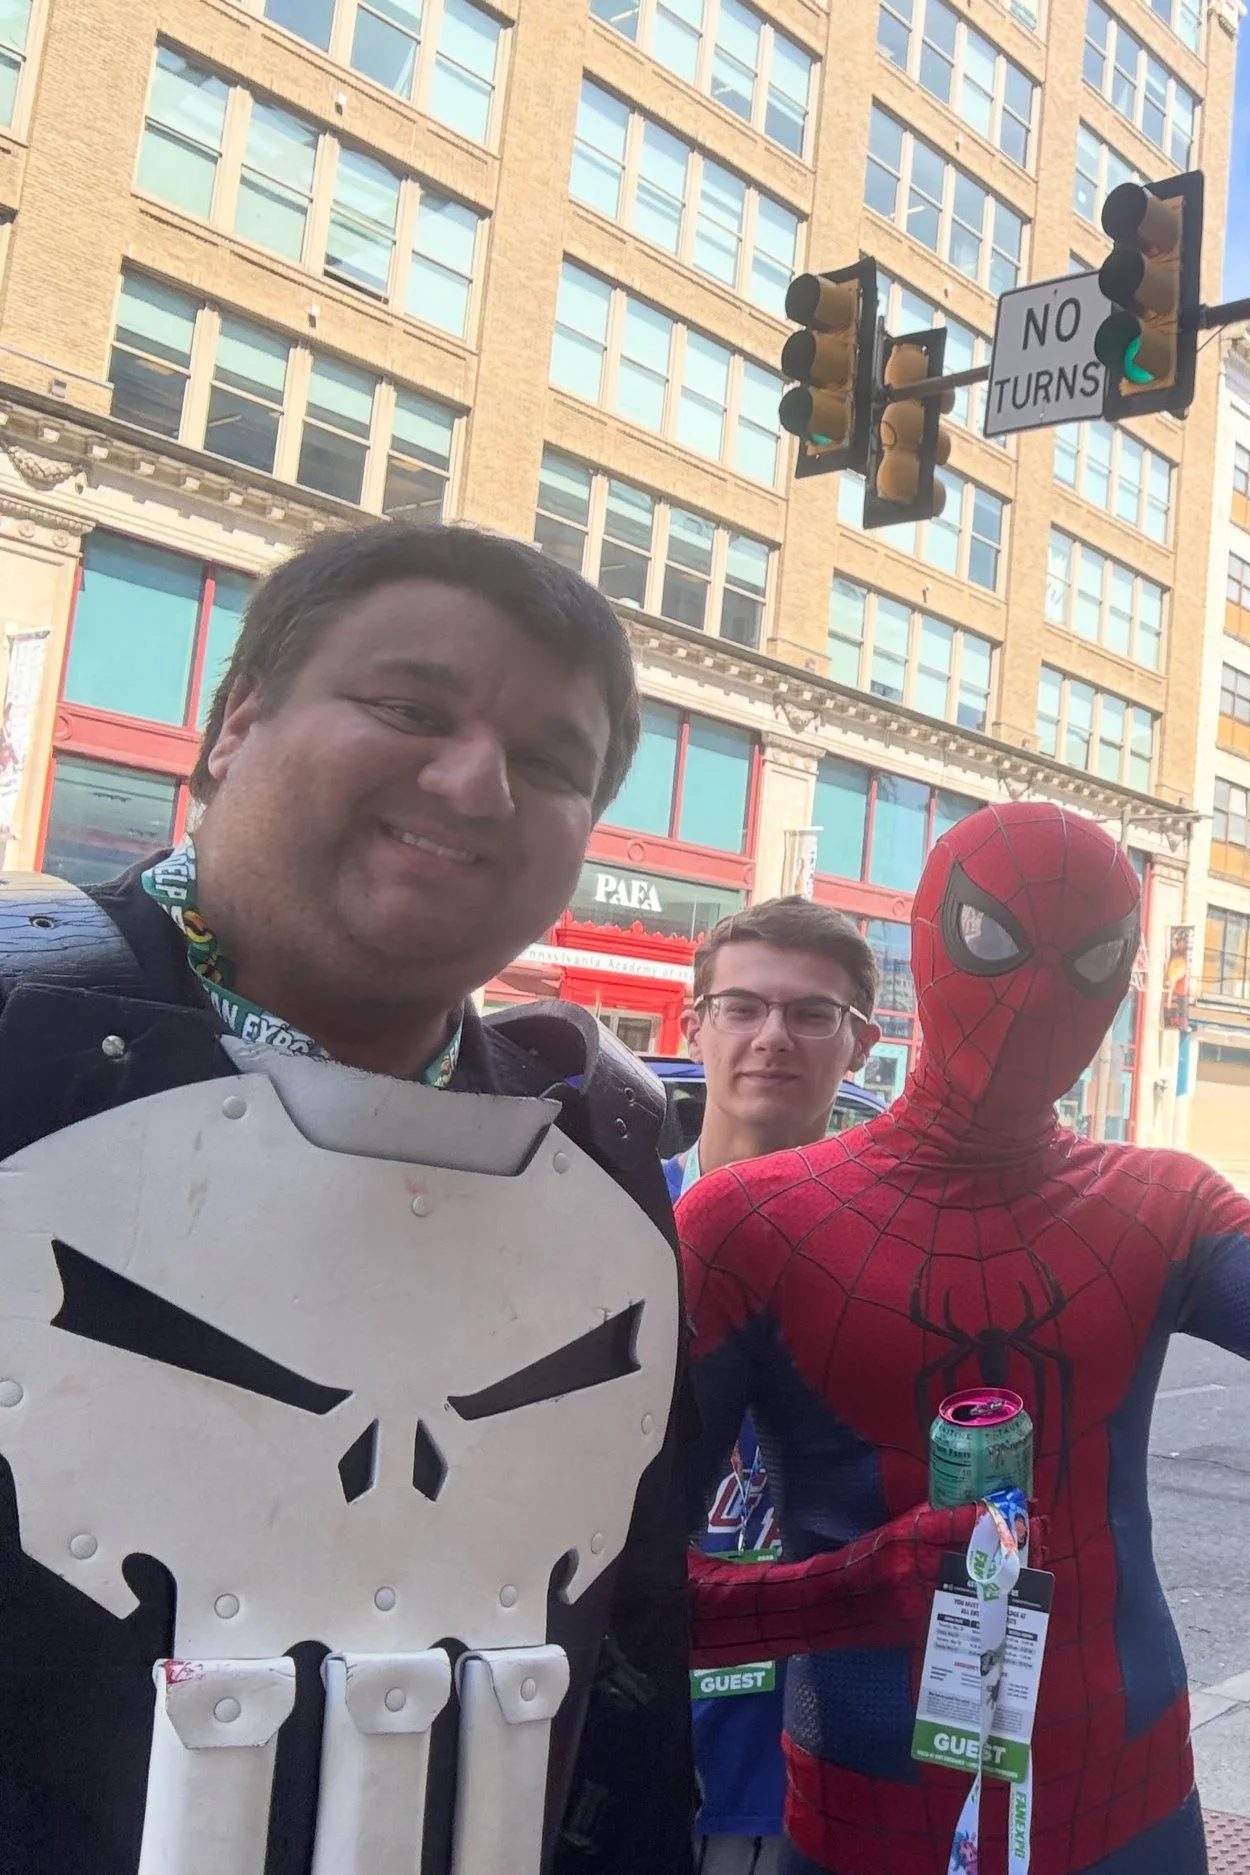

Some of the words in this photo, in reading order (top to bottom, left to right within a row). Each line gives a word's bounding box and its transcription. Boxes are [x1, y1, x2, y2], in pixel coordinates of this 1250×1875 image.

[1021, 297, 1082, 351] NO
[994, 360, 1101, 414] TURNS
[595, 872, 663, 913] PAFA
[607, 958, 658, 978] Academy
[700, 1671, 766, 1693] GUEST
[933, 1732, 1006, 1766] GUEST
